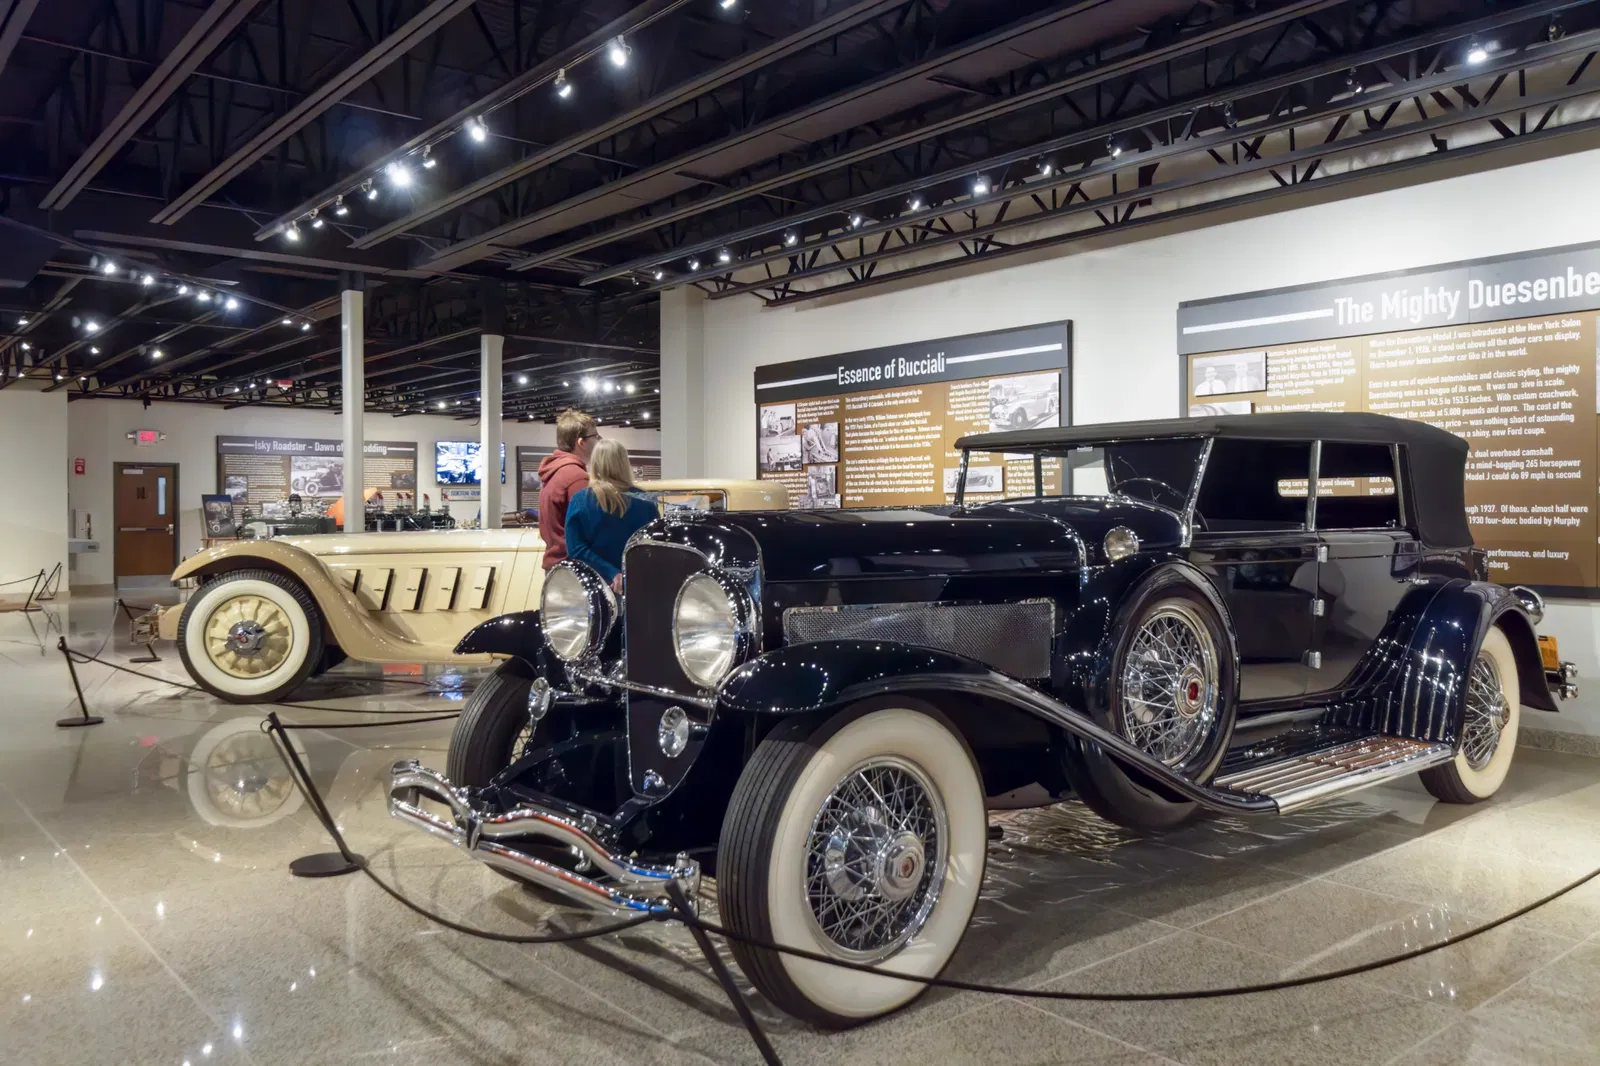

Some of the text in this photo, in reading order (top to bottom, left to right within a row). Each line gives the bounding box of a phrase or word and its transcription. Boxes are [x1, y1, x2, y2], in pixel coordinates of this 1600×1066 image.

[1335, 297, 1374, 325] The
[1381, 286, 1461, 324] Mighty
[1433, 331, 1452, 340] Model
[1452, 330, 1457, 339] J
[1472, 325, 1506, 337] introduced
[1507, 325, 1514, 333] at
[1515, 324, 1526, 332] the
[1528, 322, 1543, 331] New
[1544, 320, 1560, 329] York
[1561, 318, 1581, 328] Salon
[1438, 342, 1454, 352] stood
[1455, 342, 1466, 350] out
[1467, 340, 1486, 348] above
[1487, 338, 1495, 347] all
[1496, 337, 1507, 346] the
[1508, 336, 1526, 345] other
[1527, 335, 1543, 343] cars
[1432, 354, 1456, 363] another
[1468, 352, 1480, 360] like
[1481, 351, 1486, 359] it
[1487, 350, 1494, 358] in
[1495, 349, 1506, 357] the
[838, 352, 945, 386] Essence of Bucciali
[1440, 372, 1478, 382] automobiles
[1479, 371, 1492, 380] and
[1493, 369, 1516, 378] classic
[1543, 366, 1554, 374] the
[1556, 364, 1580, 375] mighty
[1451, 384, 1457, 393] of
[1486, 382, 1491, 390] It
[1536, 379, 1543, 387] in
[1452, 395, 1469, 404] 153.5
[1496, 393, 1511, 401] With
[1512, 392, 1537, 400] custom
[1444, 407, 1461, 416] 5,000
[1462, 406, 1485, 416] pounds
[1486, 405, 1499, 413] and
[1523, 403, 1535, 411] The
[1536, 402, 1551, 410] cost
[1552, 401, 1559, 409] of
[1561, 400, 1572, 409] the
[1445, 419, 1462, 430] price
[1484, 416, 1508, 426] nothing
[1509, 415, 1527, 423] short
[1528, 414, 1535, 423] of
[1536, 412, 1574, 423] astounding
[1507, 427, 1522, 435] Ford
[254, 440, 271, 452] Isky
[272, 441, 307, 451] Roadster
[314, 442, 336, 452] Dawn
[363, 443, 387, 456] odding
[1474, 449, 1489, 457] dual
[1490, 448, 1520, 457] overhead
[1521, 447, 1553, 456] camshaft
[1476, 460, 1524, 470] mind-boggling
[1526, 459, 1538, 467] 265
[1539, 459, 1581, 468] horsepower
[1465, 470, 1581, 481] Model J could do 89 mph in second
[1334, 478, 1355, 487] showing
[1500, 504, 1508, 513] Of
[1531, 504, 1554, 512] almost
[1555, 504, 1569, 512] half
[1468, 516, 1484, 524] 1930
[1519, 516, 1542, 524] bodied
[1543, 516, 1552, 526] by
[1553, 516, 1580, 526] Murphy
[1532, 549, 1545, 558] and
[1547, 550, 1569, 560] luxury
[1489, 560, 1510, 570] nberg.
